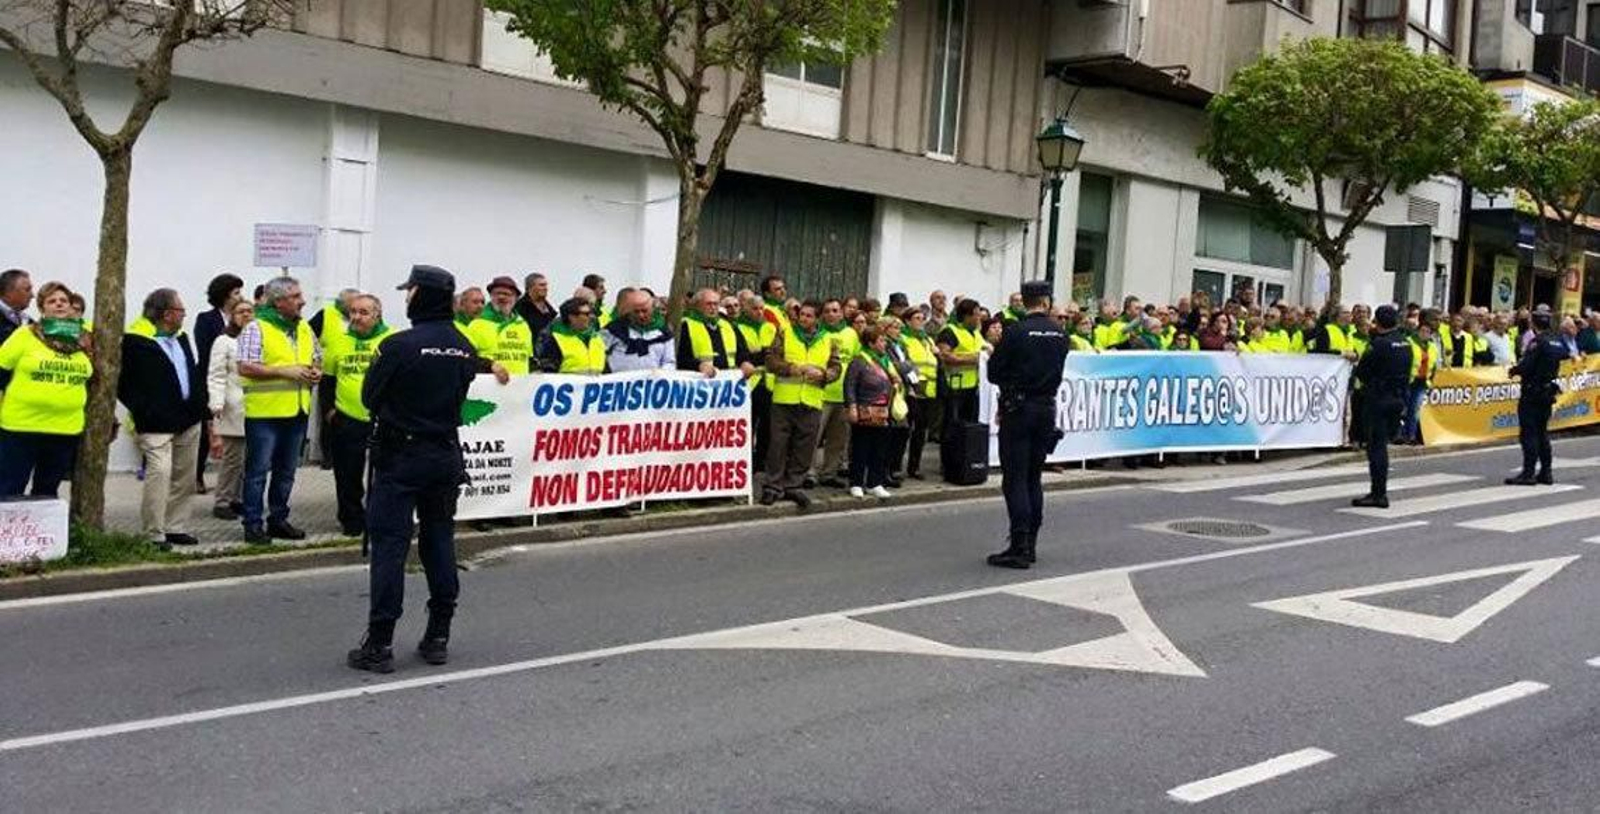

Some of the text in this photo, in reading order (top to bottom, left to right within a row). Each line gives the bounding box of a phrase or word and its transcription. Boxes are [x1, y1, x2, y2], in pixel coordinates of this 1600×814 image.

[533, 379, 746, 416] OS PENSIONISTAS
[1055, 375, 1341, 432] RANTES GALEG@S UNID@S
[461, 440, 505, 454] AJAE
[533, 418, 748, 462] FOMOS TRABALLADORES
[530, 473, 578, 507] NON
